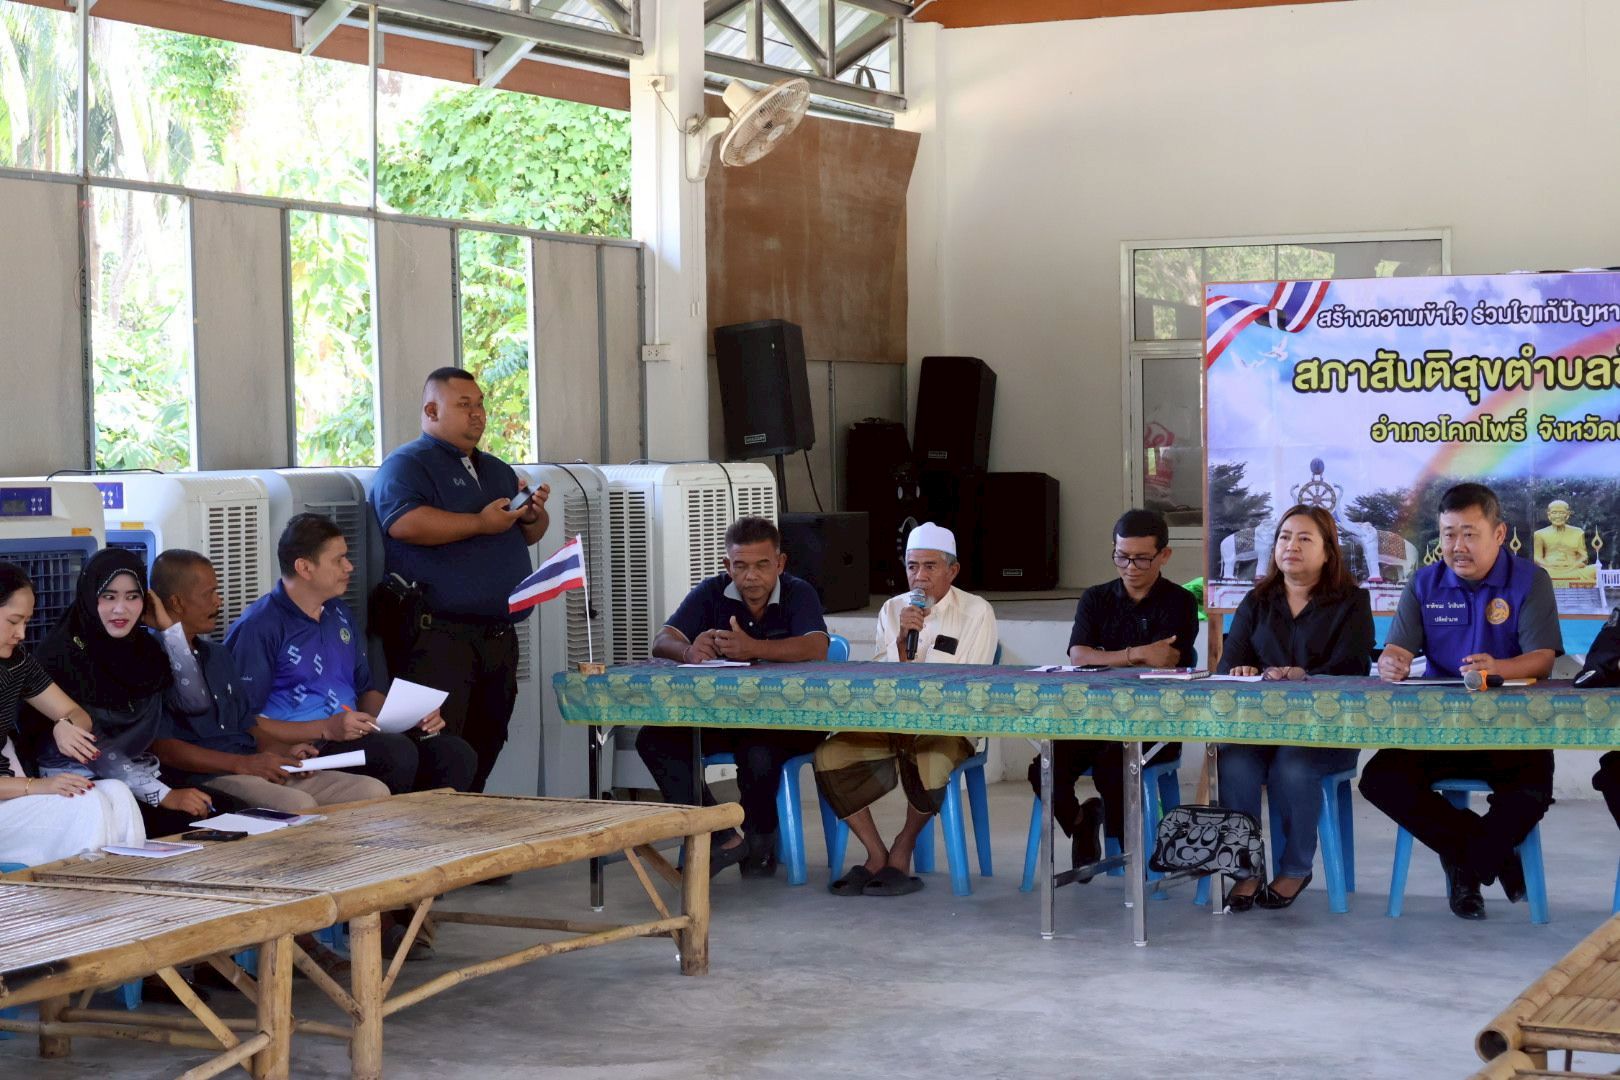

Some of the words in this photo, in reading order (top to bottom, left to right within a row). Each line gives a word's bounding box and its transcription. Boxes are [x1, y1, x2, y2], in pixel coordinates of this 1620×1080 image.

[1317, 302, 1466, 328] สร้างความเข้าใจ
[1472, 298, 1620, 326] ร่วมใจแก้ปัญหา
[1371, 409, 1527, 442] อำเภอโคกโพธิ์
